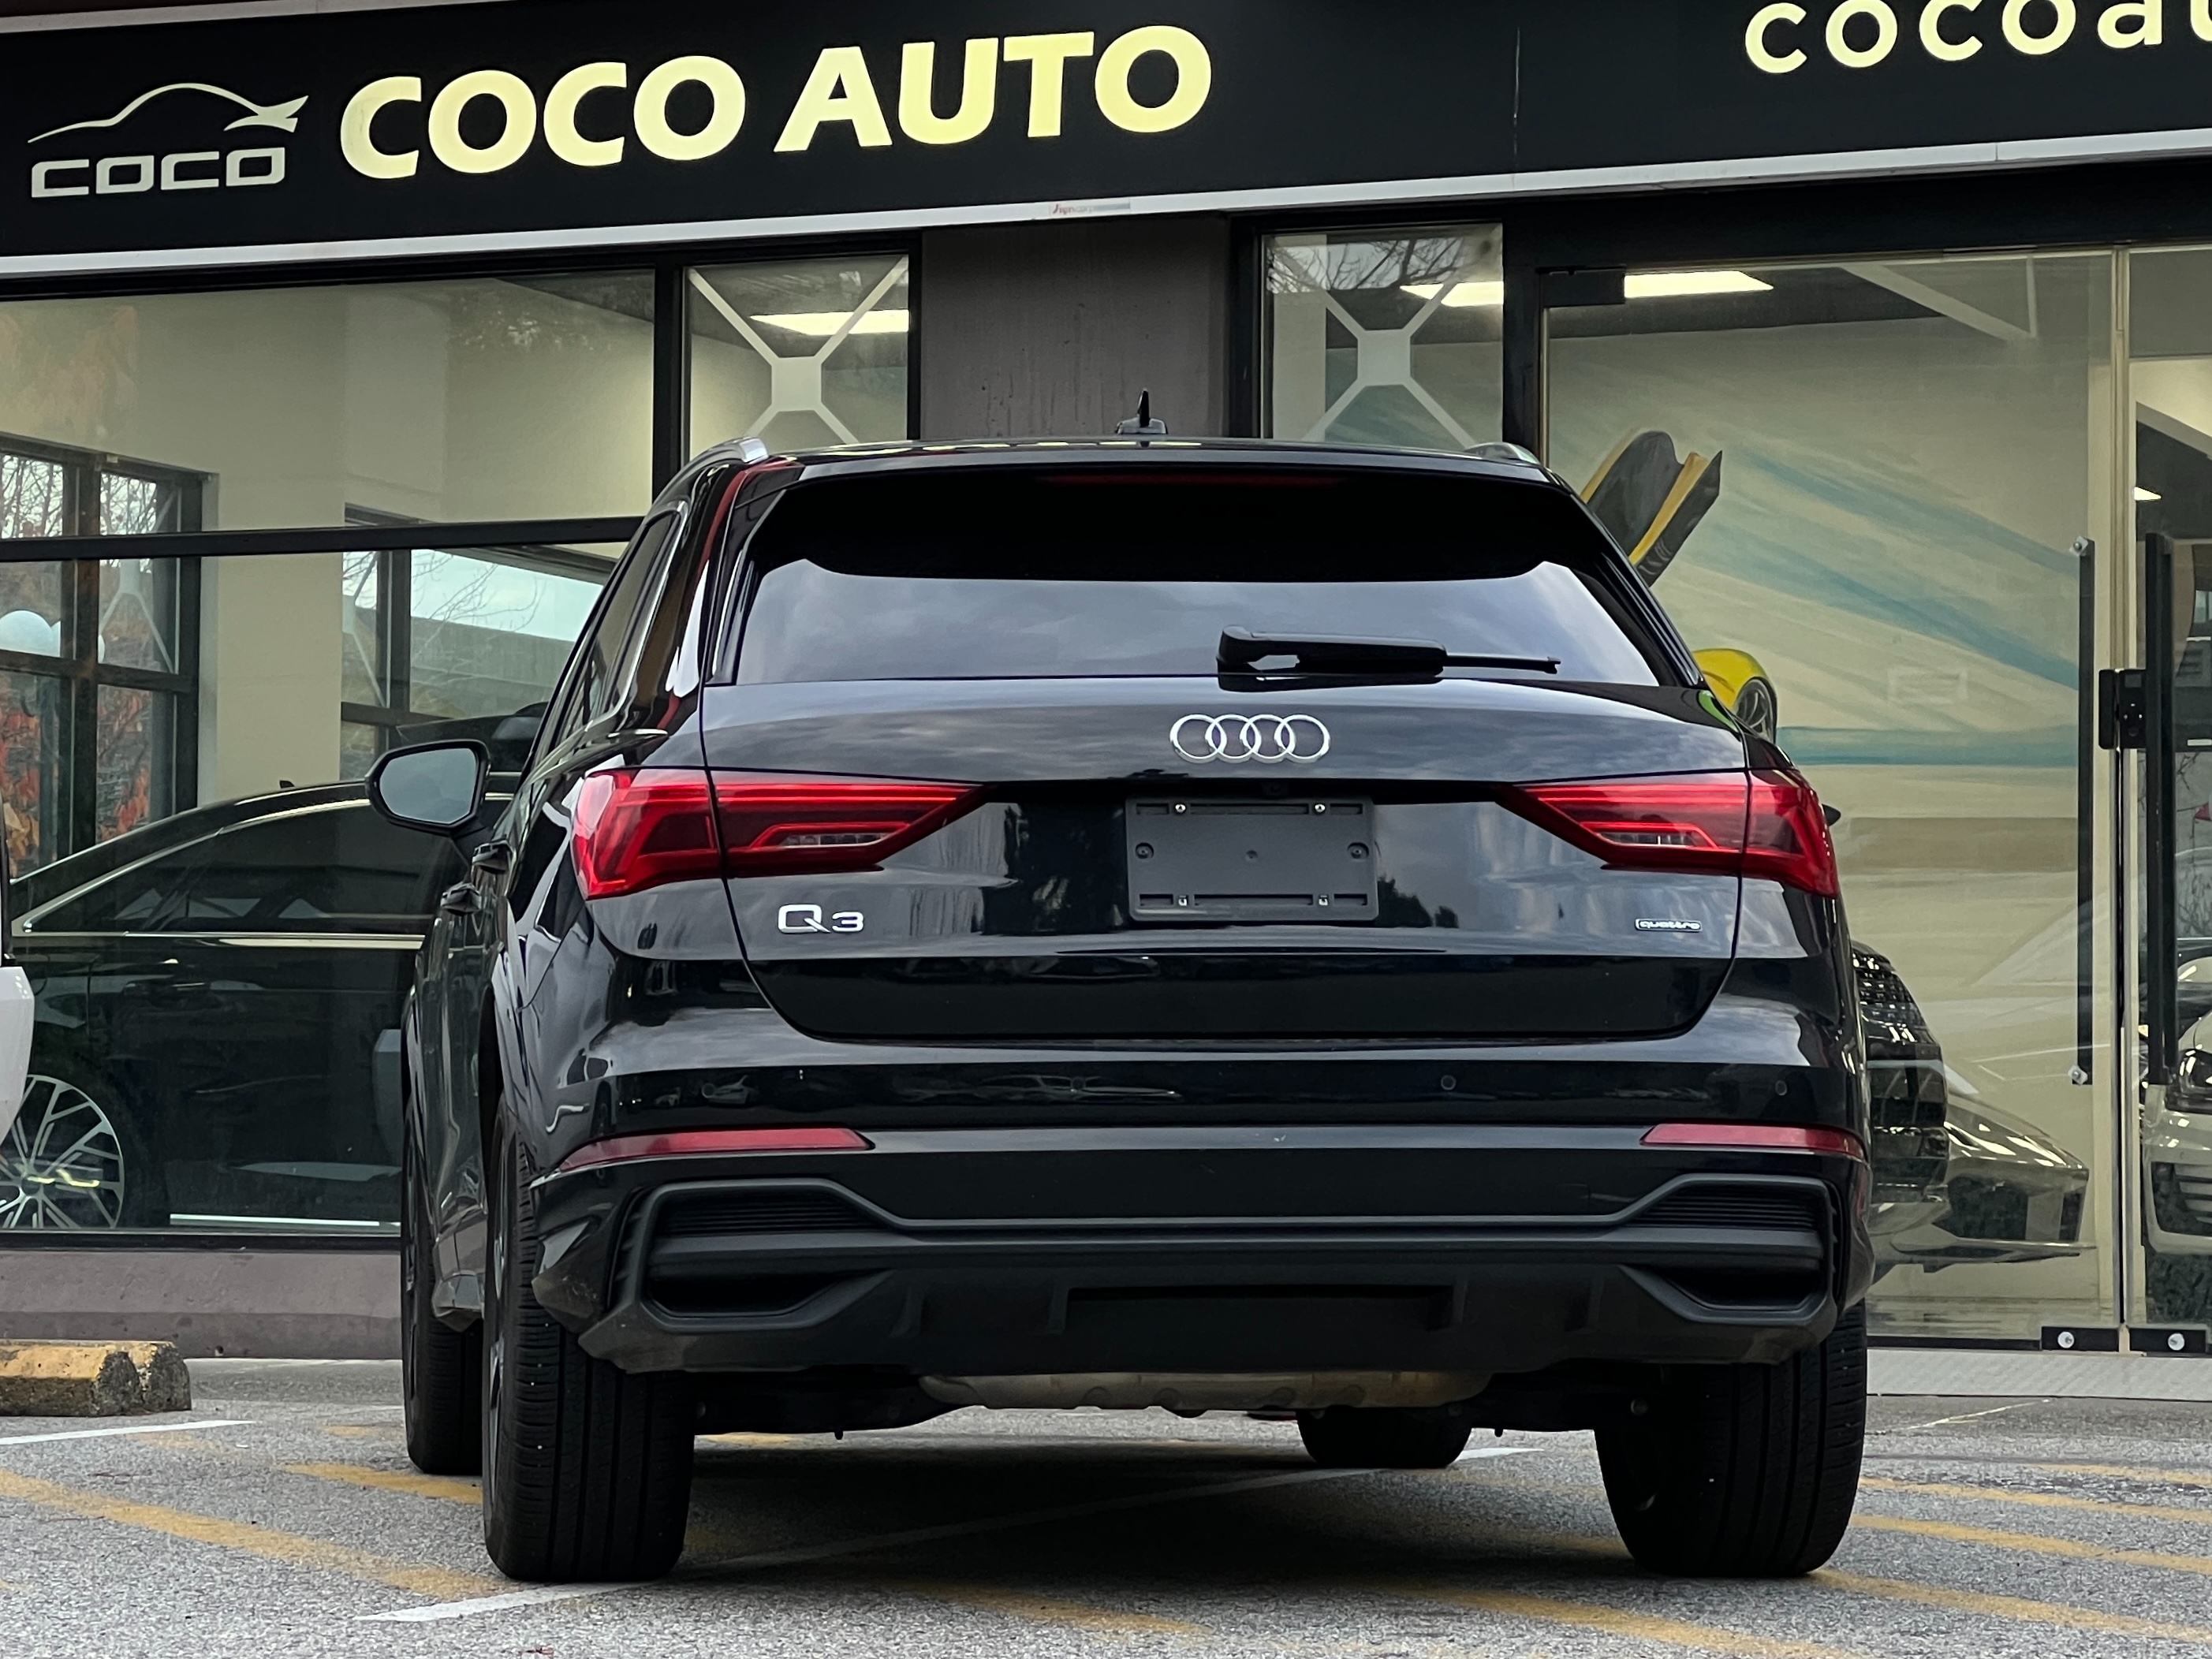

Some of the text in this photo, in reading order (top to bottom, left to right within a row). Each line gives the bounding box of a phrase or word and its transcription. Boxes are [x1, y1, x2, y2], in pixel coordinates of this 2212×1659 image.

[340, 25, 1212, 179] COCO AUTO
[32, 147, 285, 198] COCO
[778, 904, 864, 933] Q3
[1639, 920, 1700, 930] quattro
